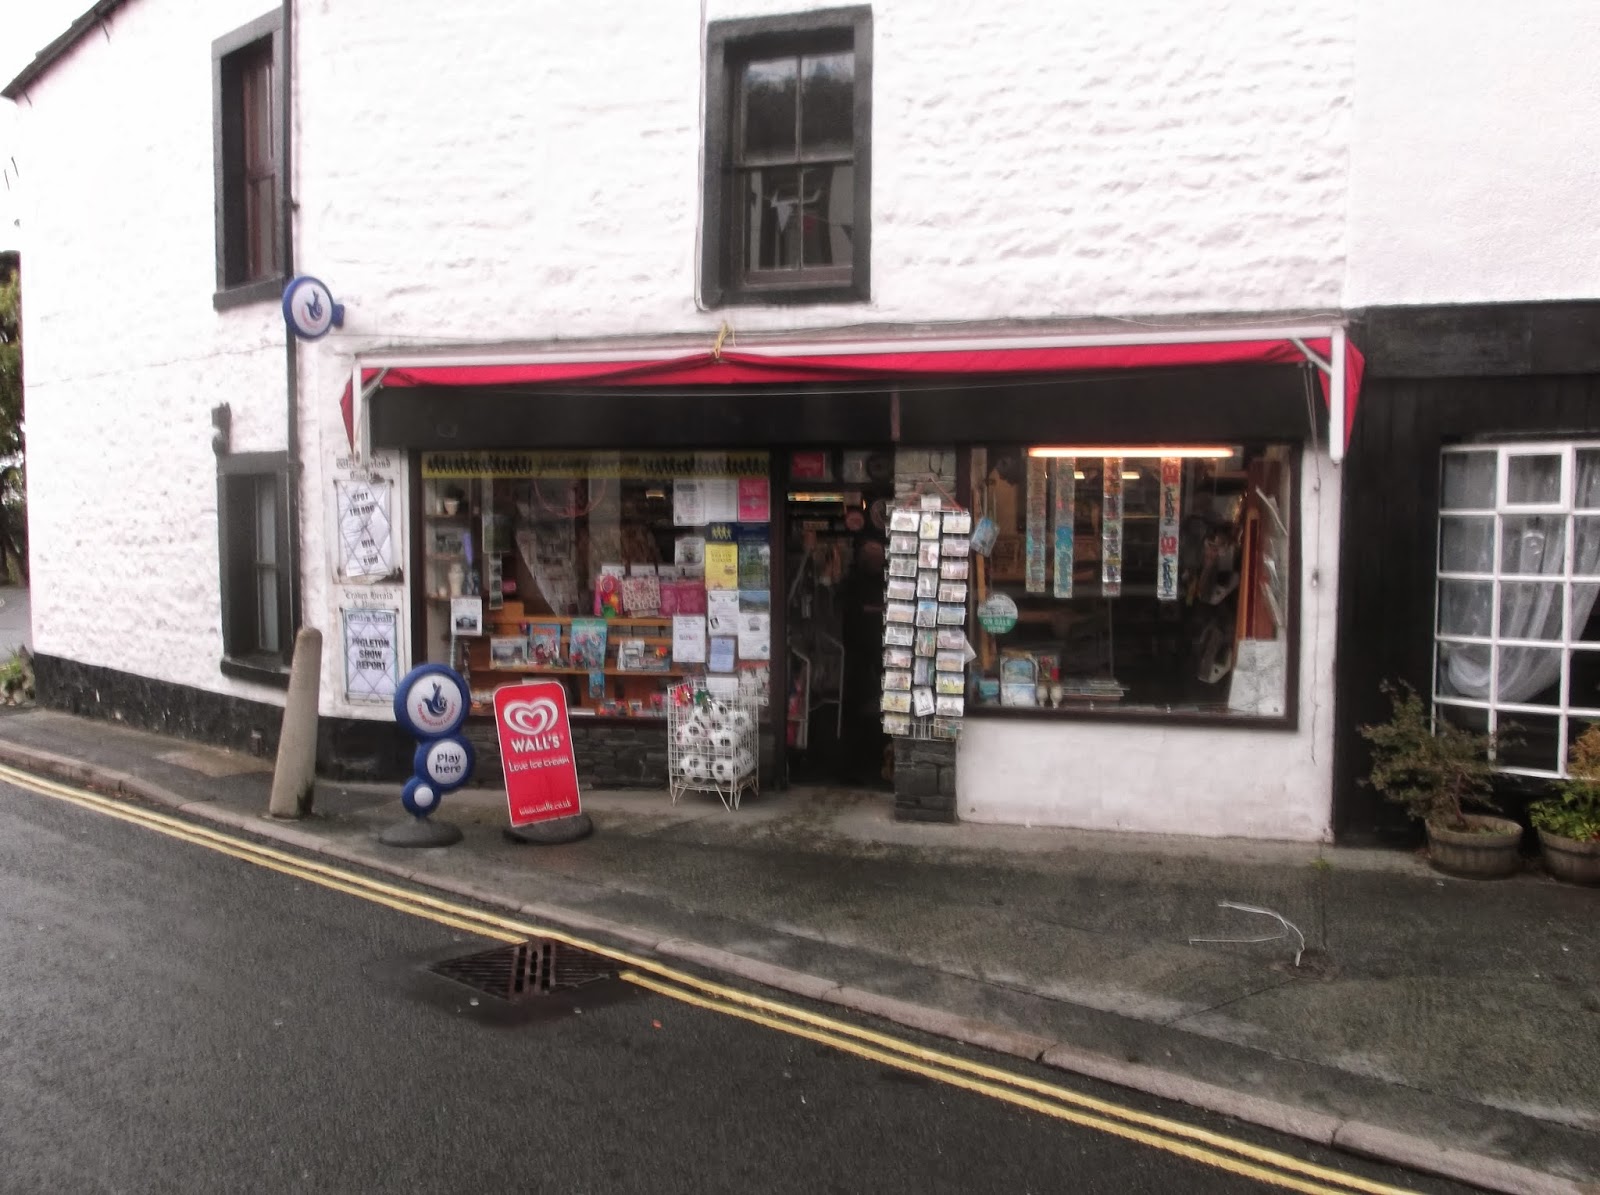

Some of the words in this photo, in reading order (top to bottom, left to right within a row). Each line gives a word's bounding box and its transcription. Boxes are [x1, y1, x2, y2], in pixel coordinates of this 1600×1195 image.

[361, 538, 376, 549] WIN
[352, 637, 390, 649] INGLETON
[358, 649, 382, 660] SHOW
[356, 661, 386, 671] REPORT
[511, 735, 561, 754] WALL'S
[436, 753, 461, 764] Play
[435, 764, 461, 775] here
[508, 759, 529, 773] Love
[543, 757, 569, 768] cream
